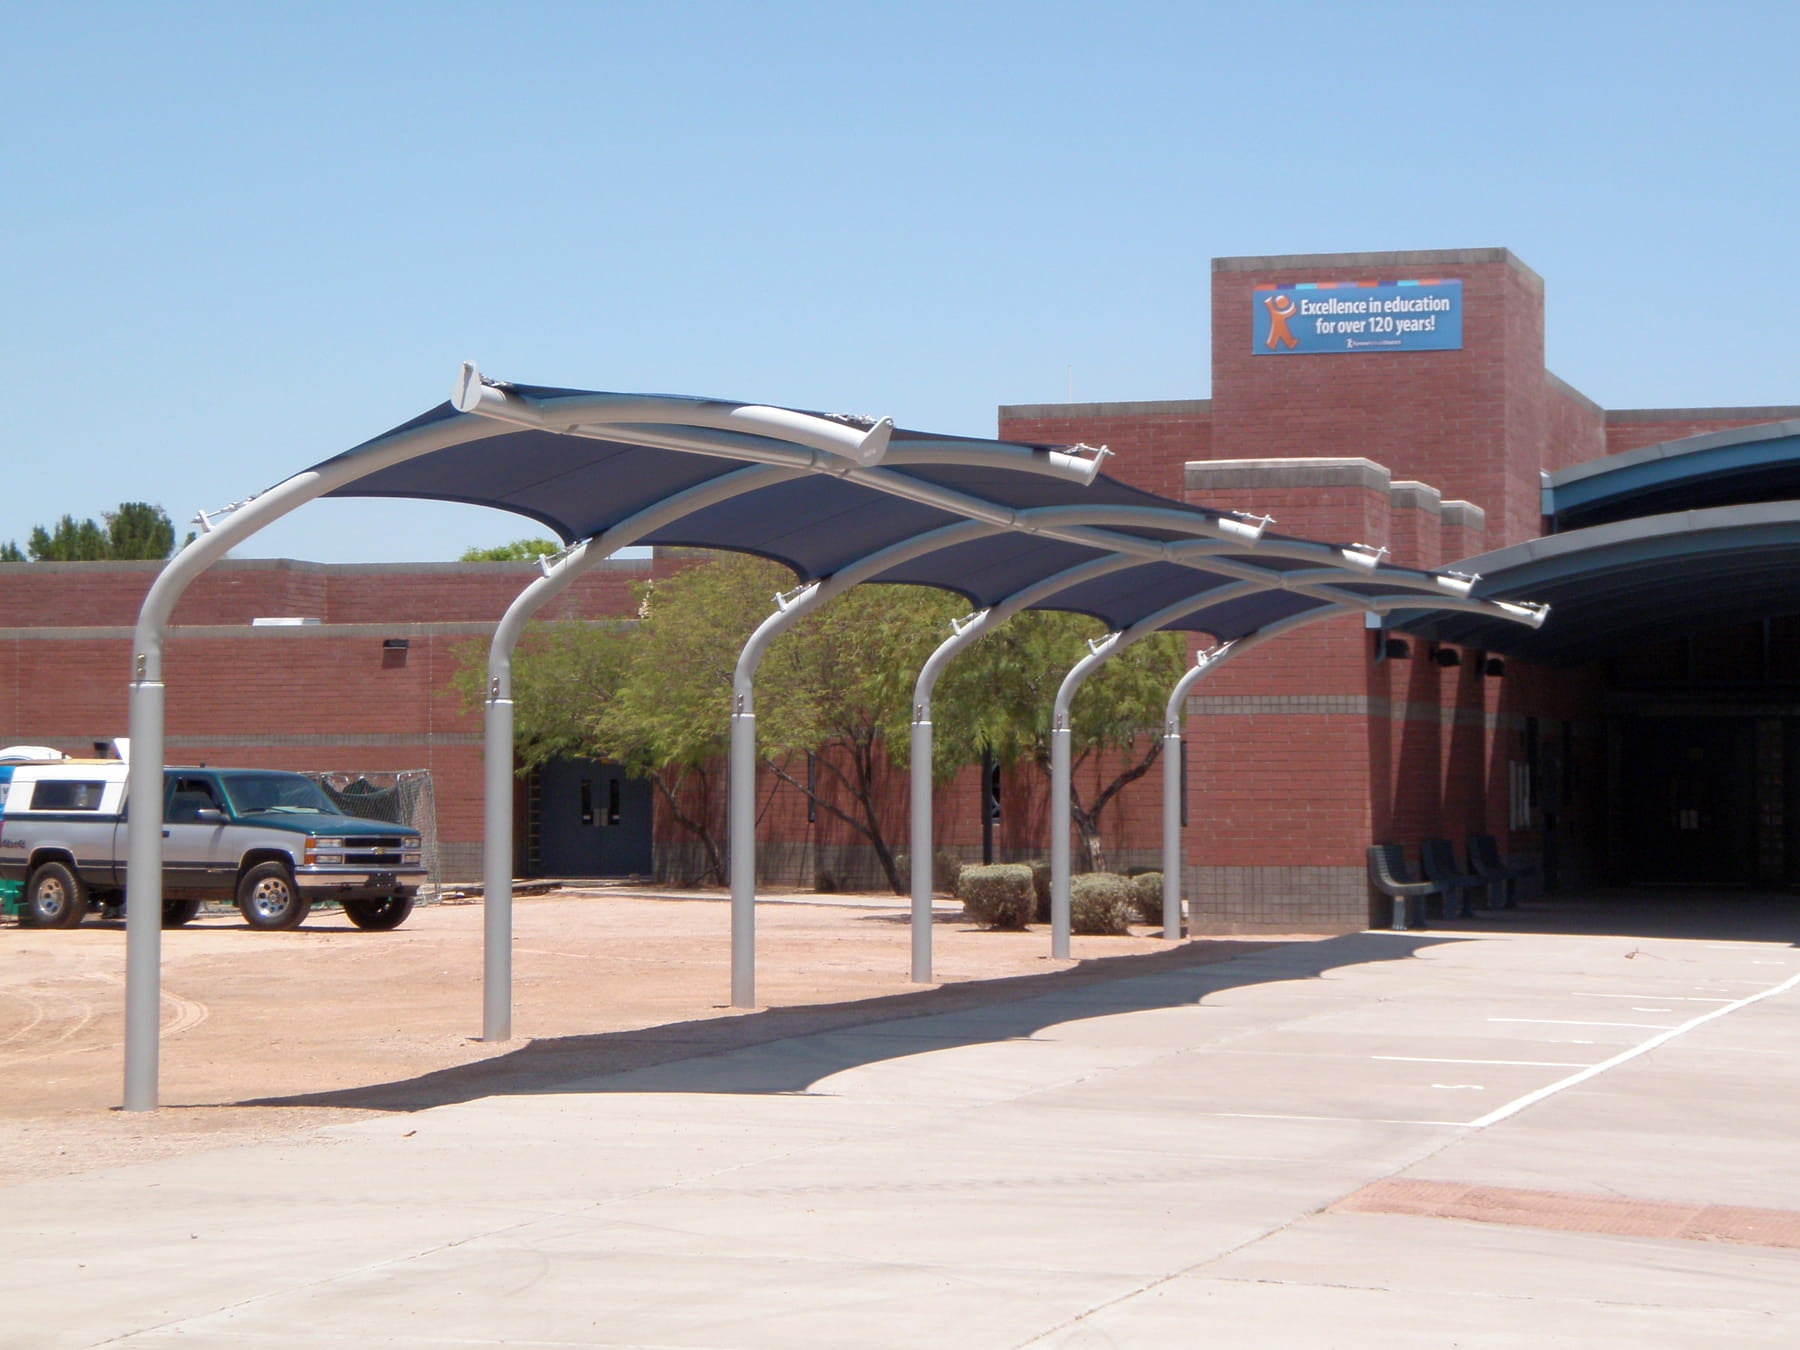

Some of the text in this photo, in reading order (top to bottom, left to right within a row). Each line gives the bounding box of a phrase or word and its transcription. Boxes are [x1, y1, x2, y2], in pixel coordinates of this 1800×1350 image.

[1301, 295, 1450, 315] Excellence in education
[1316, 315, 1436, 336] for over 120 years!
